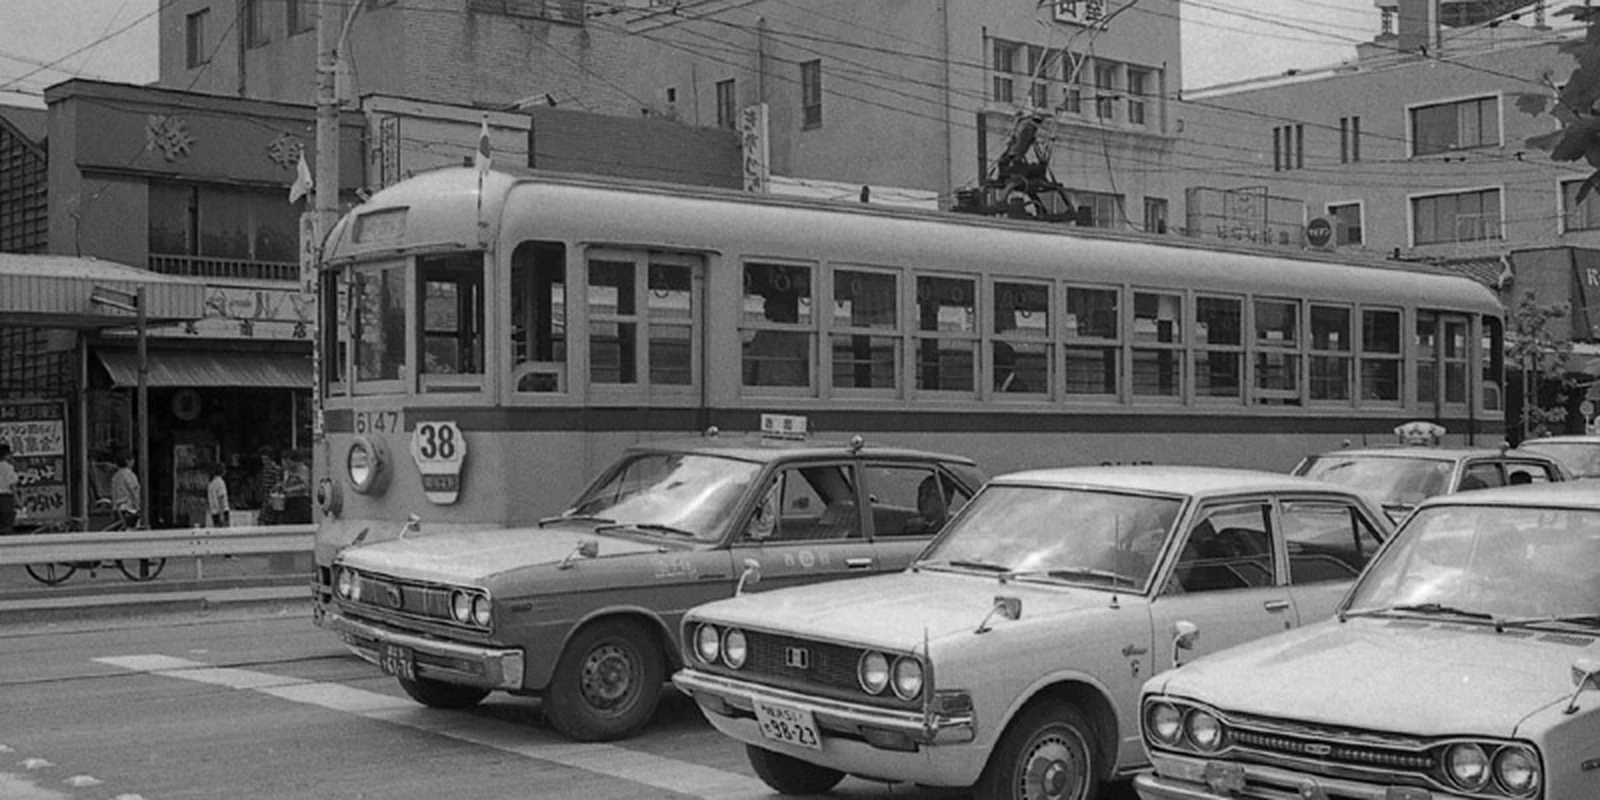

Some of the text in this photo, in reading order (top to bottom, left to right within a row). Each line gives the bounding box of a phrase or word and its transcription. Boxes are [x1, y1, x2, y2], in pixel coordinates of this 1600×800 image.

[356, 411, 398, 434] 6147
[420, 424, 455, 459] 38
[770, 719, 817, 745] 98-23
